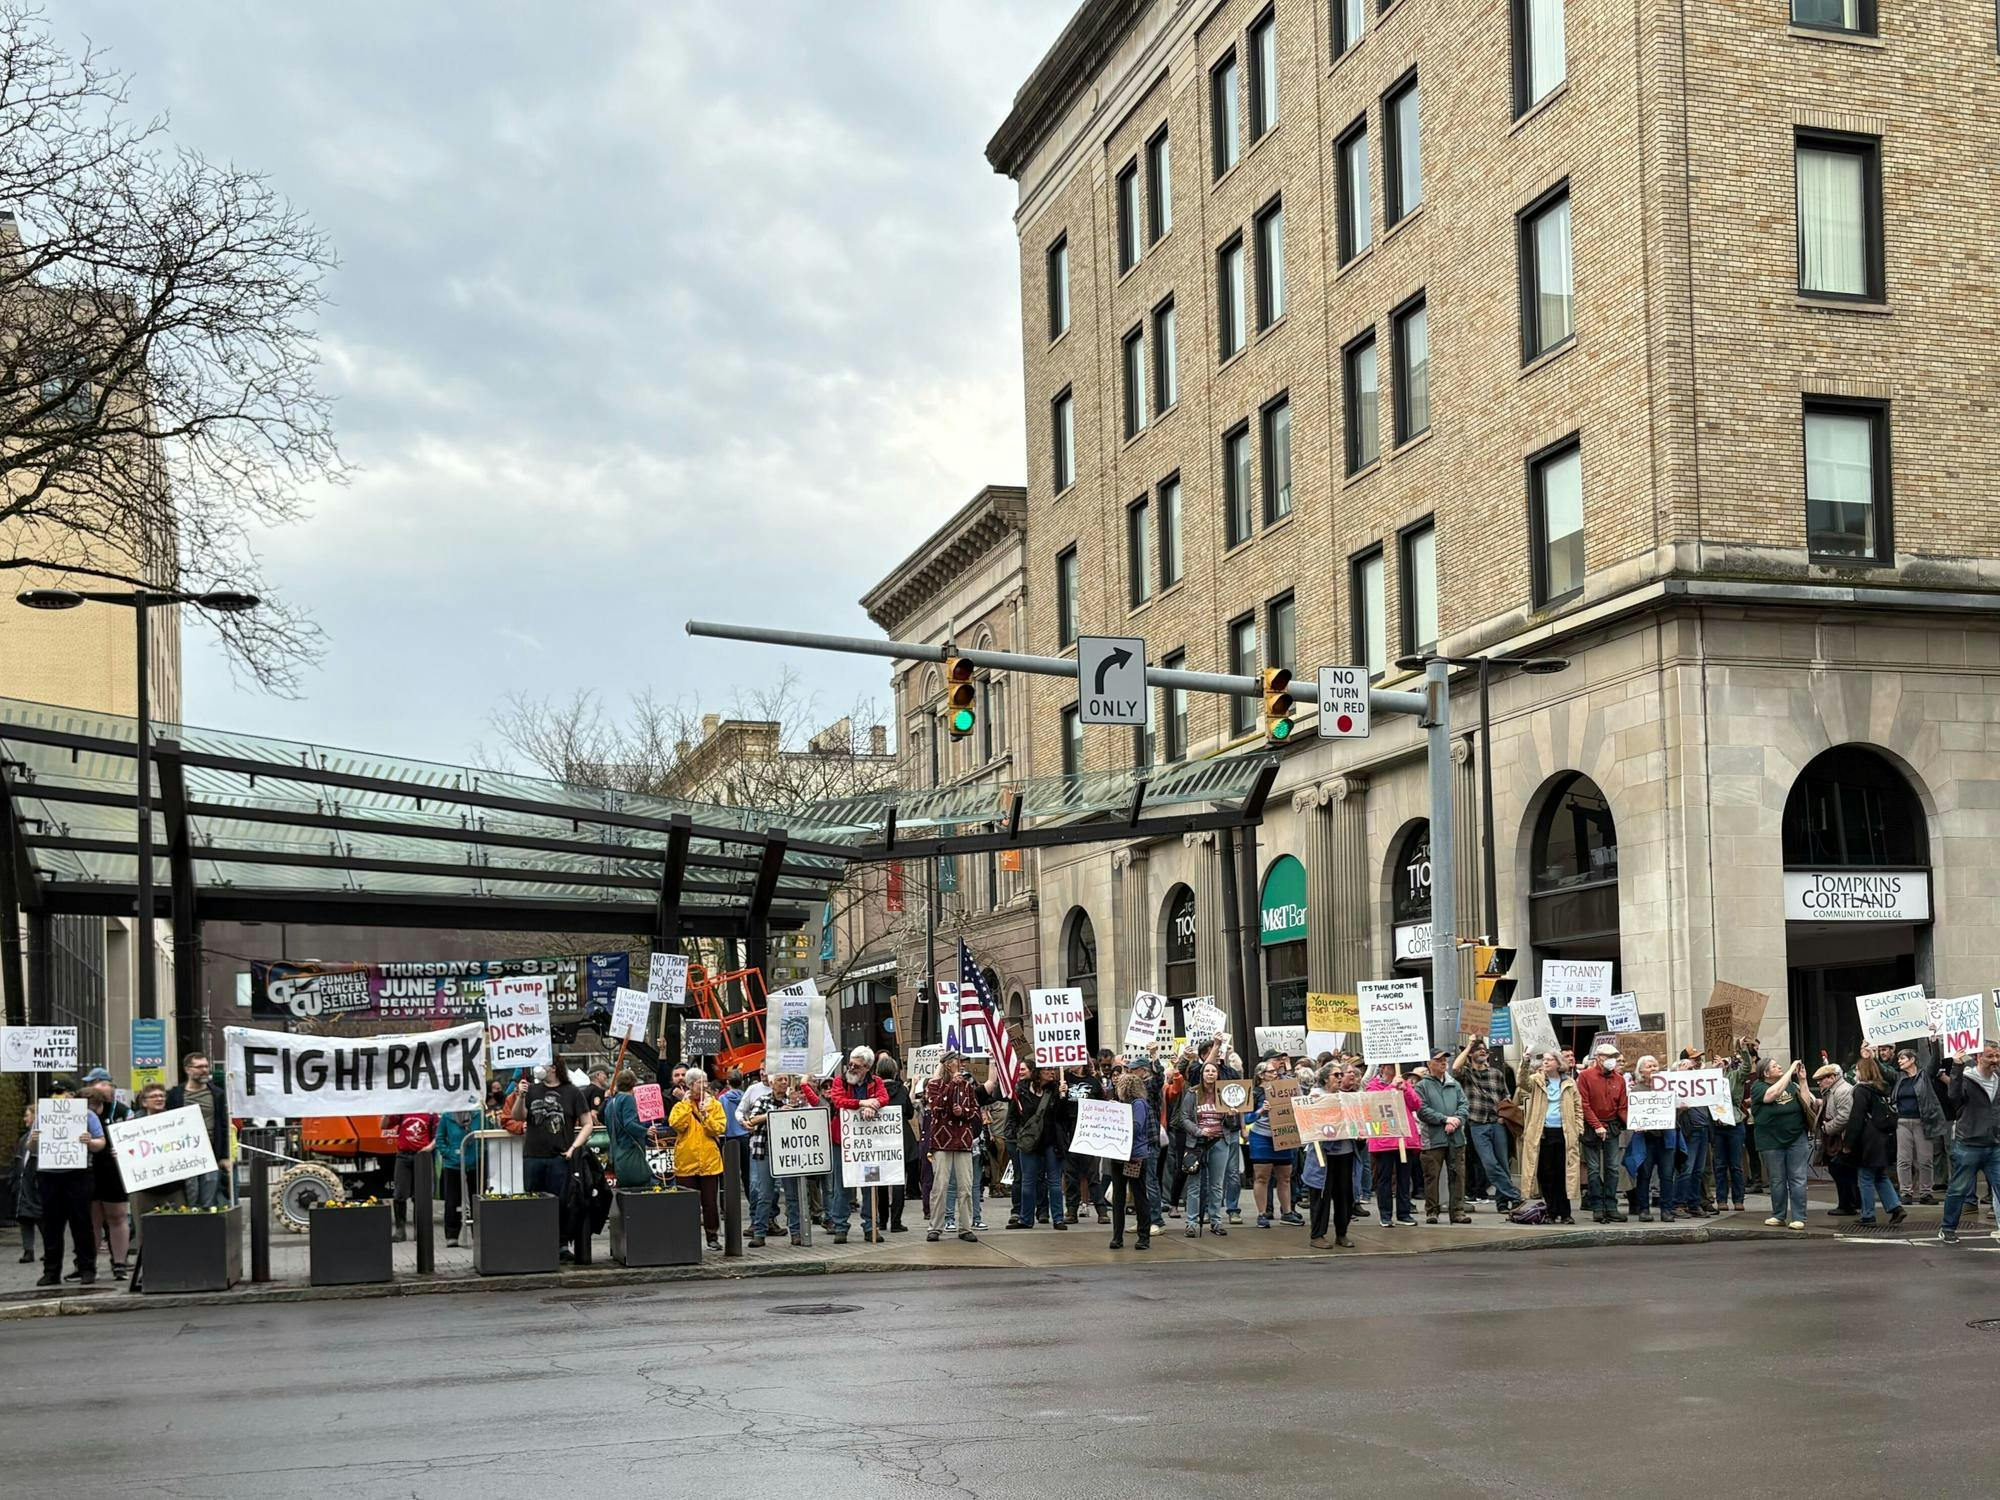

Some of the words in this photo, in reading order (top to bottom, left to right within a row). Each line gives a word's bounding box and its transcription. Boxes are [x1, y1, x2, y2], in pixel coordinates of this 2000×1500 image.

[1333, 671, 1354, 684] NO
[1330, 687, 1359, 699] TURN
[1089, 699, 1137, 717] ONLY
[1323, 702, 1340, 713] ON
[1344, 702, 1365, 714] RED
[1811, 874, 1902, 893] TOMPKINS
[1802, 890, 1896, 909] CORTLAND
[1262, 905, 1289, 933] M&T
[1813, 910, 1865, 918] COMMUNITY
[1867, 910, 1902, 918] COLLEGE
[653, 955, 665, 966] NO
[378, 962, 481, 977] THURSDAYS
[486, 961, 504, 975] 5
[651, 967, 664, 977] NO
[666, 968, 685, 977] KKK
[1547, 965, 1605, 978] TYRANNY
[320, 970, 367, 986] SUMMER
[563, 973, 577, 991] 4
[320, 981, 368, 996] CONCERT
[379, 978, 437, 998] JUNE
[443, 978, 457, 995] 5
[485, 980, 543, 997] Trump
[650, 983, 684, 993] FASCIST
[1374, 984, 1389, 992] TIME
[322, 991, 370, 1009] SERIES
[379, 997, 435, 1008] BERNIE
[444, 996, 487, 1007] MILTO
[658, 992, 674, 1001] USA
[1045, 994, 1069, 1006] ONE
[1376, 992, 1404, 1000] F-WORD
[1864, 989, 1924, 1011] EDUCATION
[488, 1004, 513, 1019] Has
[1370, 1002, 1413, 1012] FASCISM
[1880, 1006, 1901, 1019] NOT
[1034, 1011, 1082, 1025] NATION
[1522, 1013, 1538, 1028] OFF
[1868, 1014, 1929, 1039] PREDATION
[47, 1038, 70, 1046] LIES
[1038, 1029, 1081, 1042] UNDER
[1263, 1030, 1285, 1042] WHY
[1286, 1029, 1297, 1039] SO
[1946, 1028, 1980, 1053] NOW
[33, 1046, 78, 1058] MATTER
[497, 1045, 538, 1060] Energy
[1036, 1044, 1086, 1064] SIEGE
[32, 1060, 59, 1069] TRUMP
[243, 1046, 379, 1096] FIGHT
[386, 1037, 483, 1092] BACK
[1269, 1085, 1298, 1098] Jesus
[53, 1100, 71, 1111] NO
[1294, 1097, 1315, 1106] THE
[1378, 1104, 1394, 1118] IS
[791, 1116, 807, 1130] NO
[842, 1123, 902, 1136] OLIGARCHS
[53, 1127, 69, 1138] NO
[41, 1141, 84, 1154] FASCIST
[138, 1133, 200, 1158] Diversity
[781, 1134, 820, 1150] MOTOR
[842, 1136, 873, 1150] GRAB
[843, 1149, 903, 1163] EVERYTHING
[132, 1167, 148, 1183] but
[152, 1166, 166, 1177] not
